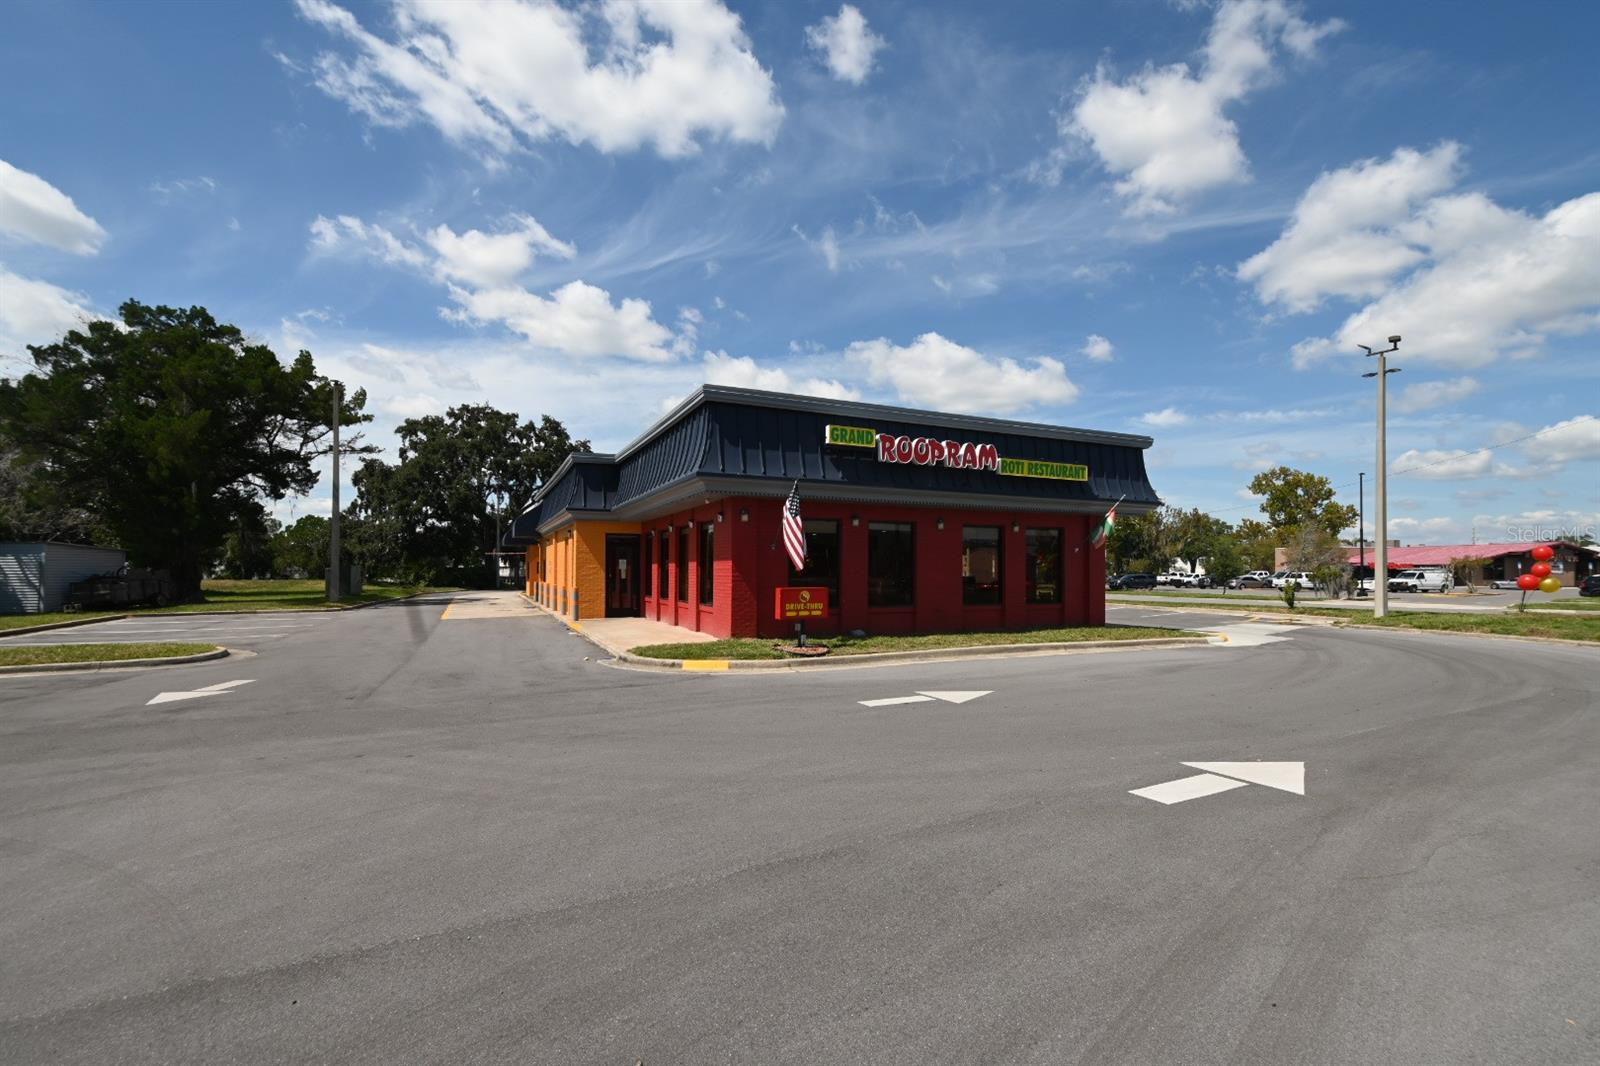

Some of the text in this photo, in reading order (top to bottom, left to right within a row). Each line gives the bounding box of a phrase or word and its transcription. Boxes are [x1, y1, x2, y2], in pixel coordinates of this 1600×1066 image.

[831, 427, 874, 445] GRAND
[878, 433, 998, 471] ROOPRAM
[1001, 460, 1086, 480] ROTI RESTAURANT
[785, 602, 824, 610] DRIVE-THRU
